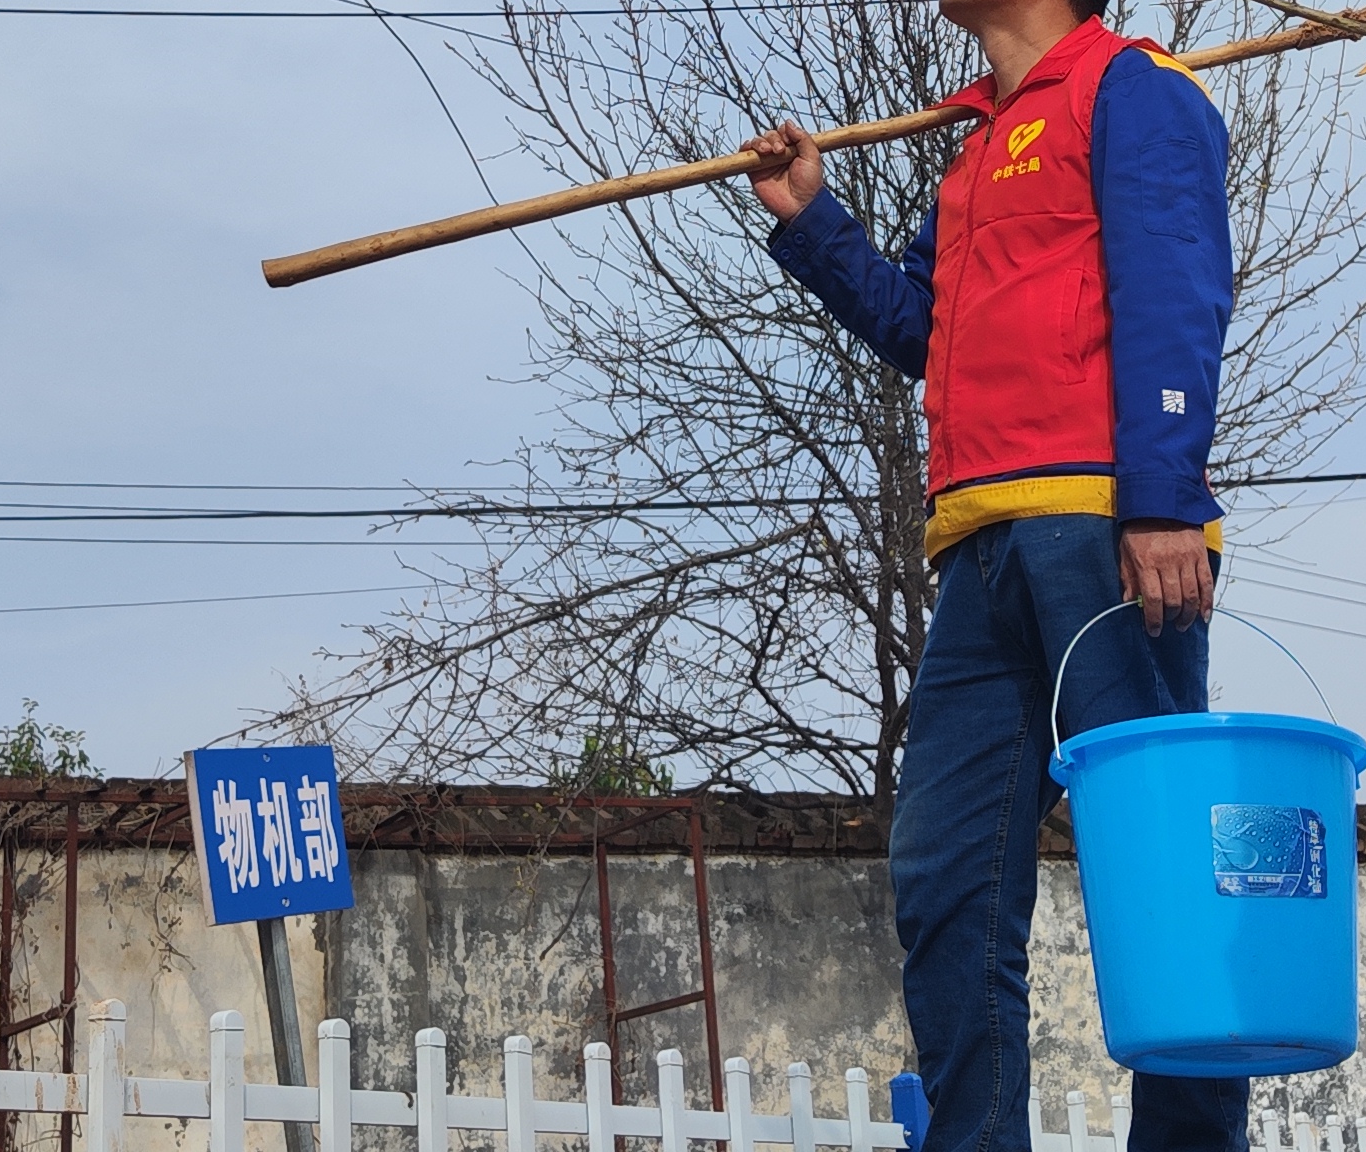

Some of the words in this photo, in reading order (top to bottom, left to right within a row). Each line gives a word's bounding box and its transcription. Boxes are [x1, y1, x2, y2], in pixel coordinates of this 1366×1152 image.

[991, 156, 1041, 183] 中铁七局
[212, 774, 340, 894] 物机部
